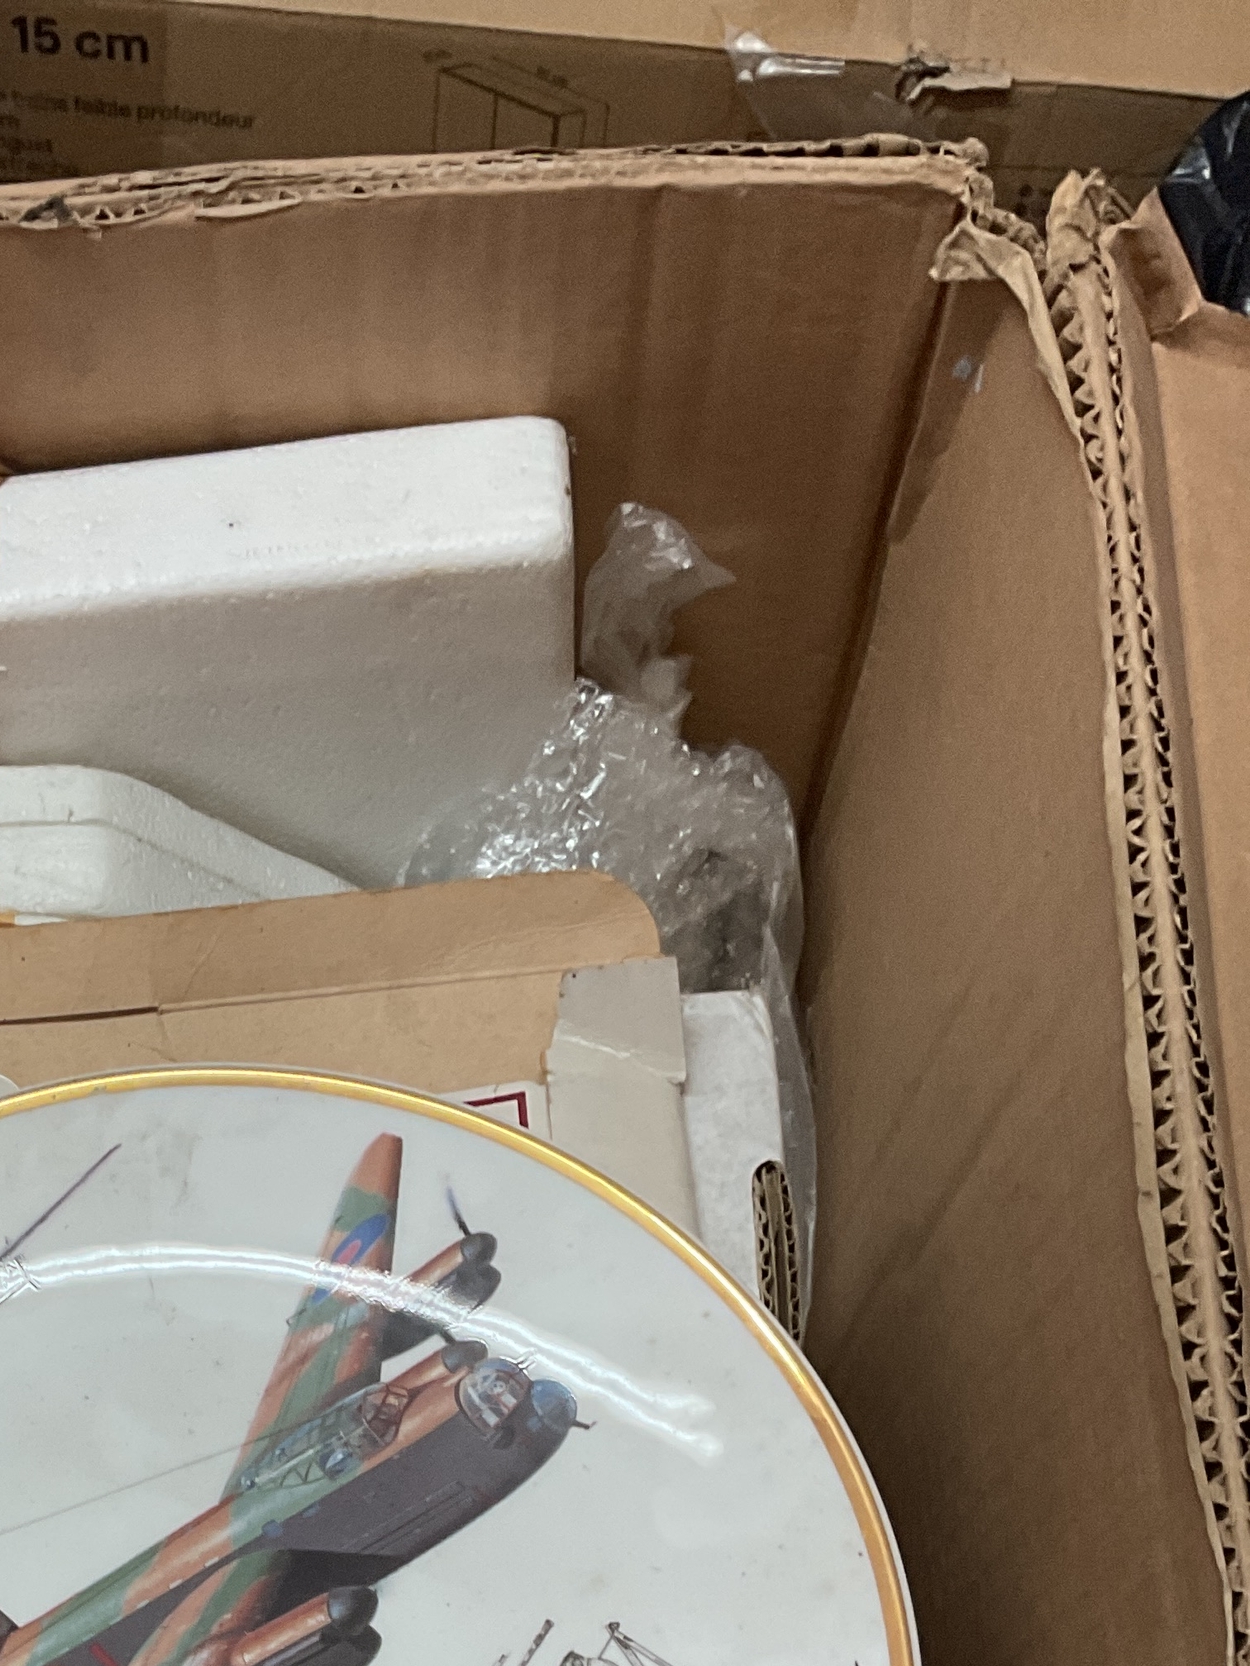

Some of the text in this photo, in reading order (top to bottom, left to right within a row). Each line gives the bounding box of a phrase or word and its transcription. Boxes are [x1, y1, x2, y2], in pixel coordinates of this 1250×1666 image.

[11, 15, 62, 56] 15
[75, 30, 149, 63] cm
[136, 102, 256, 130] profondeur
